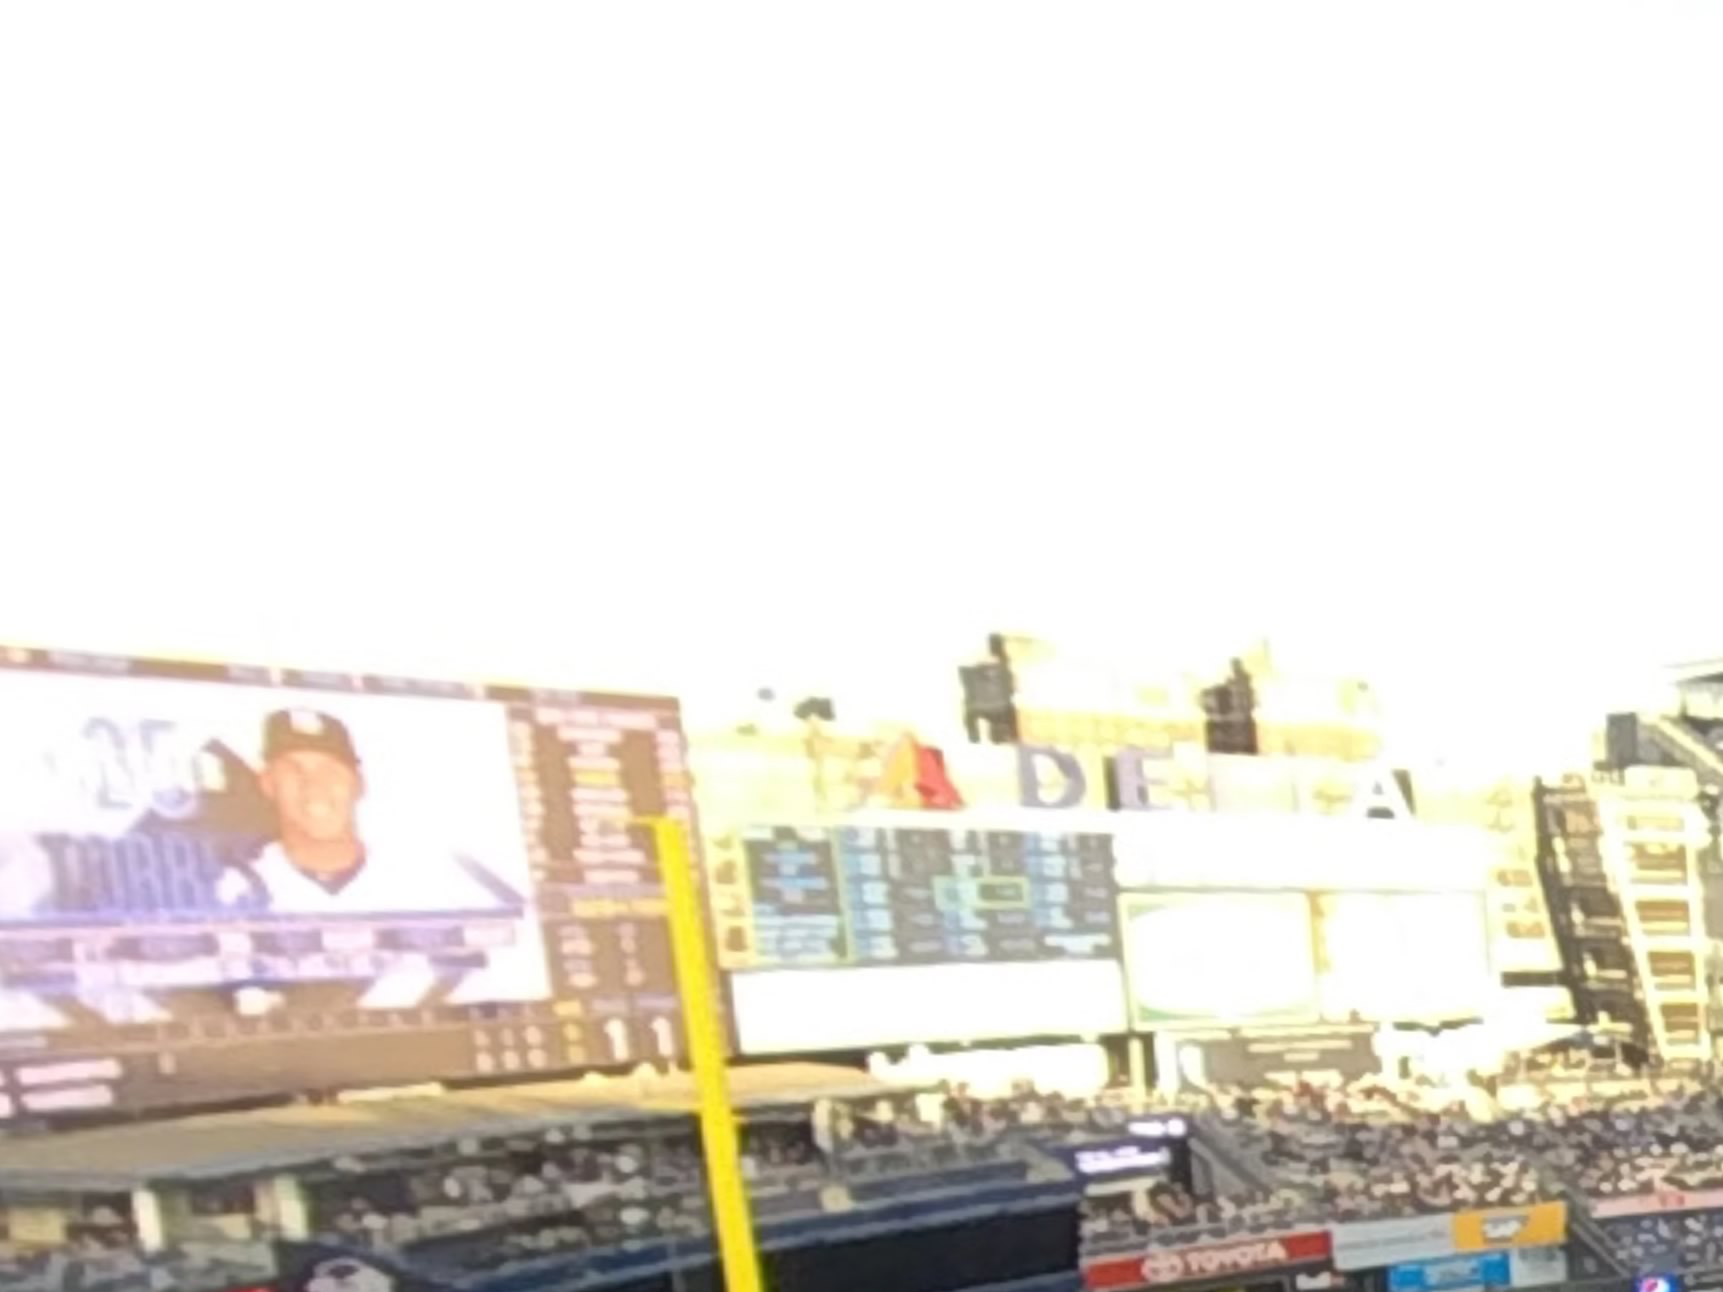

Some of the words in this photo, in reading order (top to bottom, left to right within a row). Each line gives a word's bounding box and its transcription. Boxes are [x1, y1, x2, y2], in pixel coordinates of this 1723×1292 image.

[1017, 744, 1414, 820] DEA
[35, 830, 270, 912] TORR
[1185, 1240, 1288, 1274] TOYOTA
